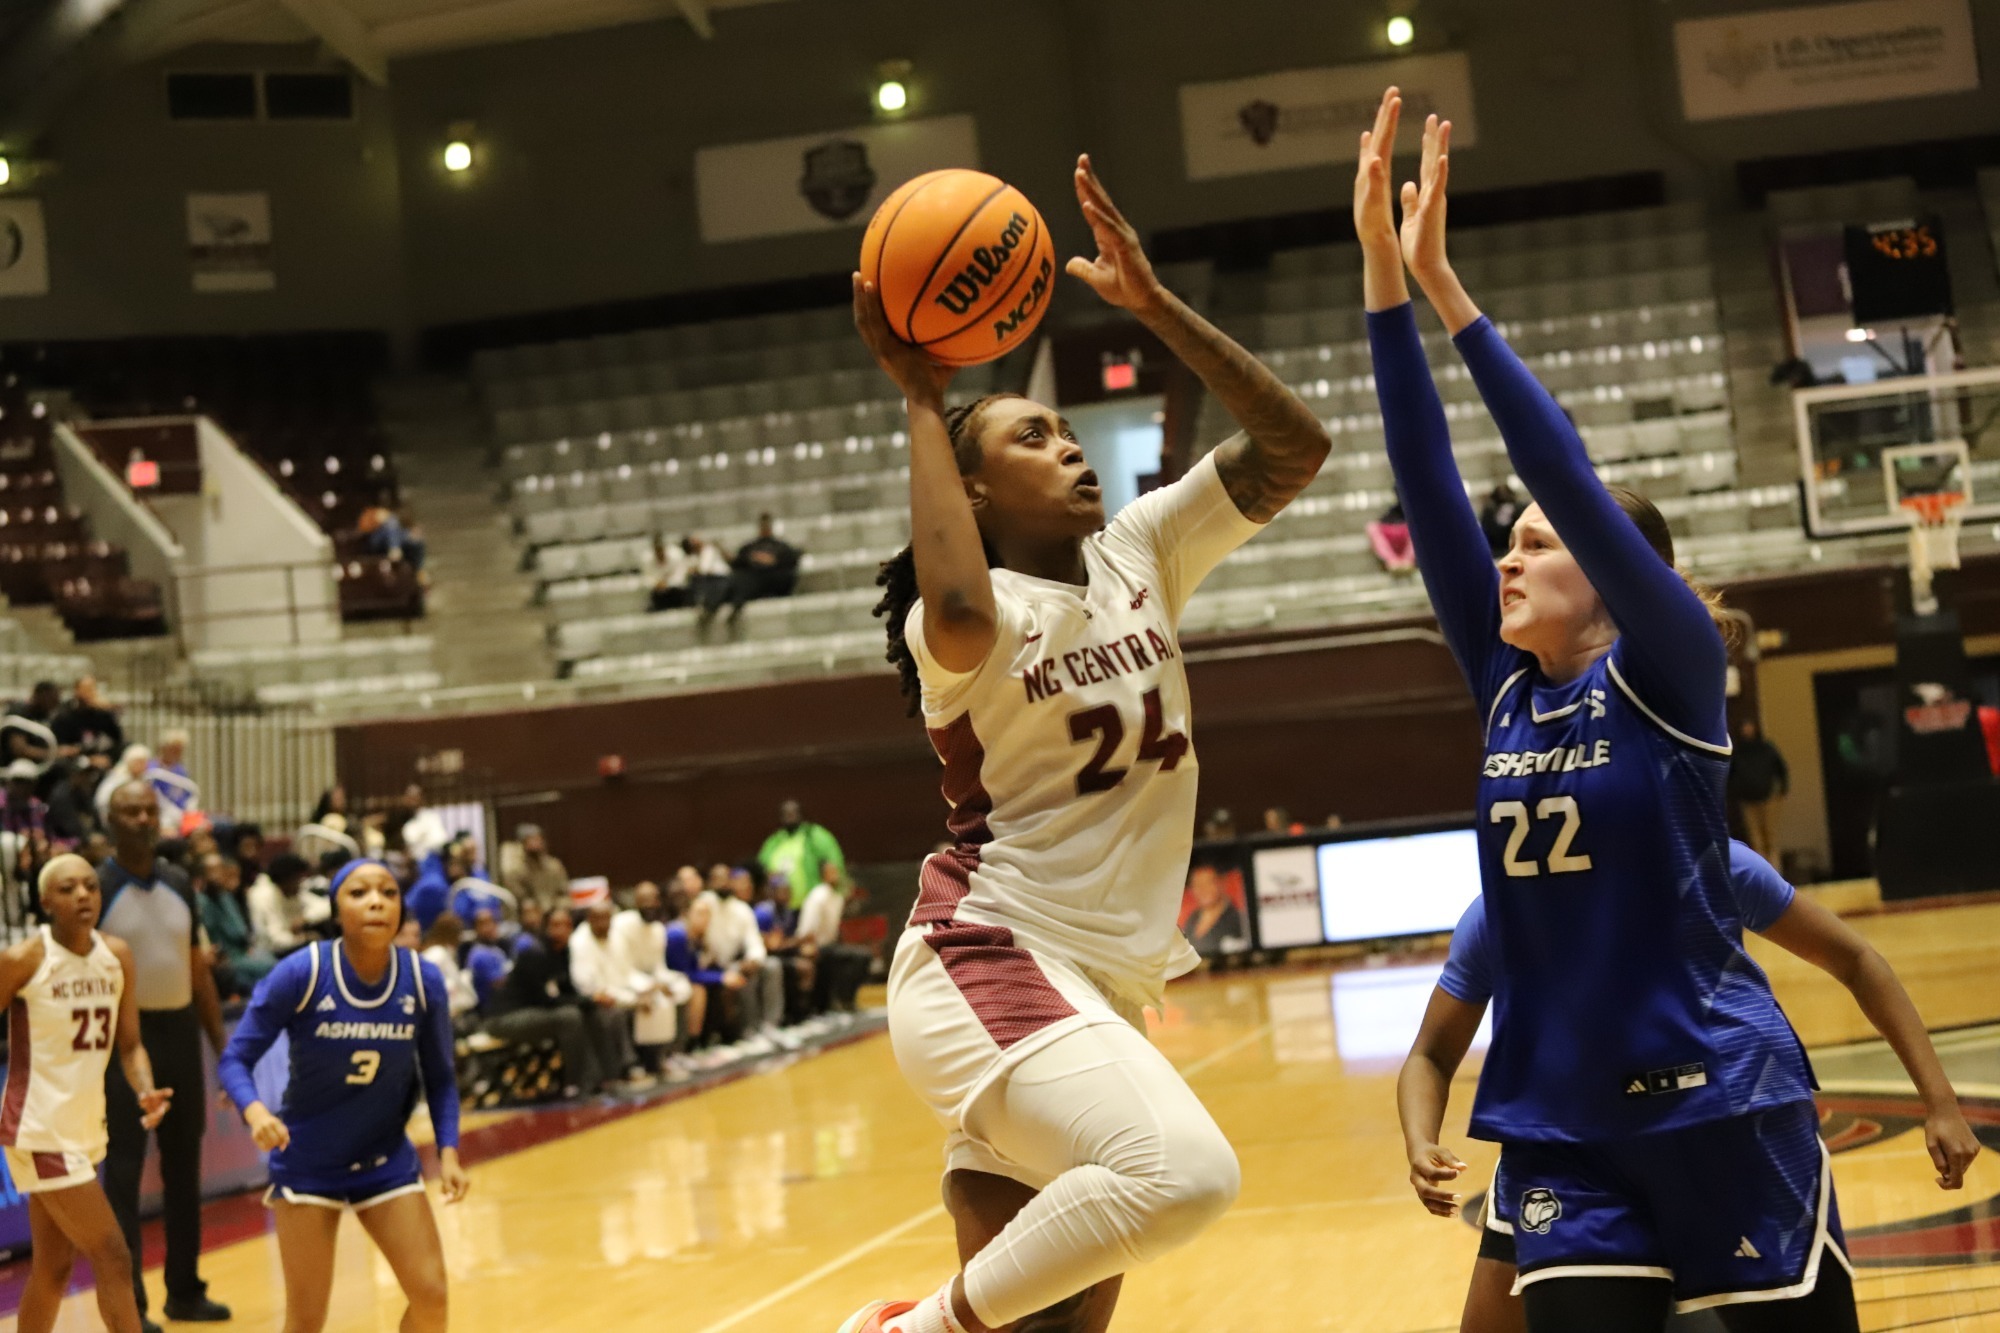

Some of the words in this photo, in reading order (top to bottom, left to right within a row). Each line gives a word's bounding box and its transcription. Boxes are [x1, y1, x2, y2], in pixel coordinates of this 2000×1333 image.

[935, 211, 1029, 316] Wilson
[993, 256, 1051, 341] NCAA
[1023, 657, 1063, 703] NC
[1067, 685, 1189, 796] 24
[1490, 796, 1593, 877] 22
[52, 982, 69, 999] NC
[73, 978, 117, 997] CENTRA
[71, 1007, 112, 1051] 23
[315, 1021, 416, 1041] ASHEVILLE
[345, 1050, 381, 1085] 3
